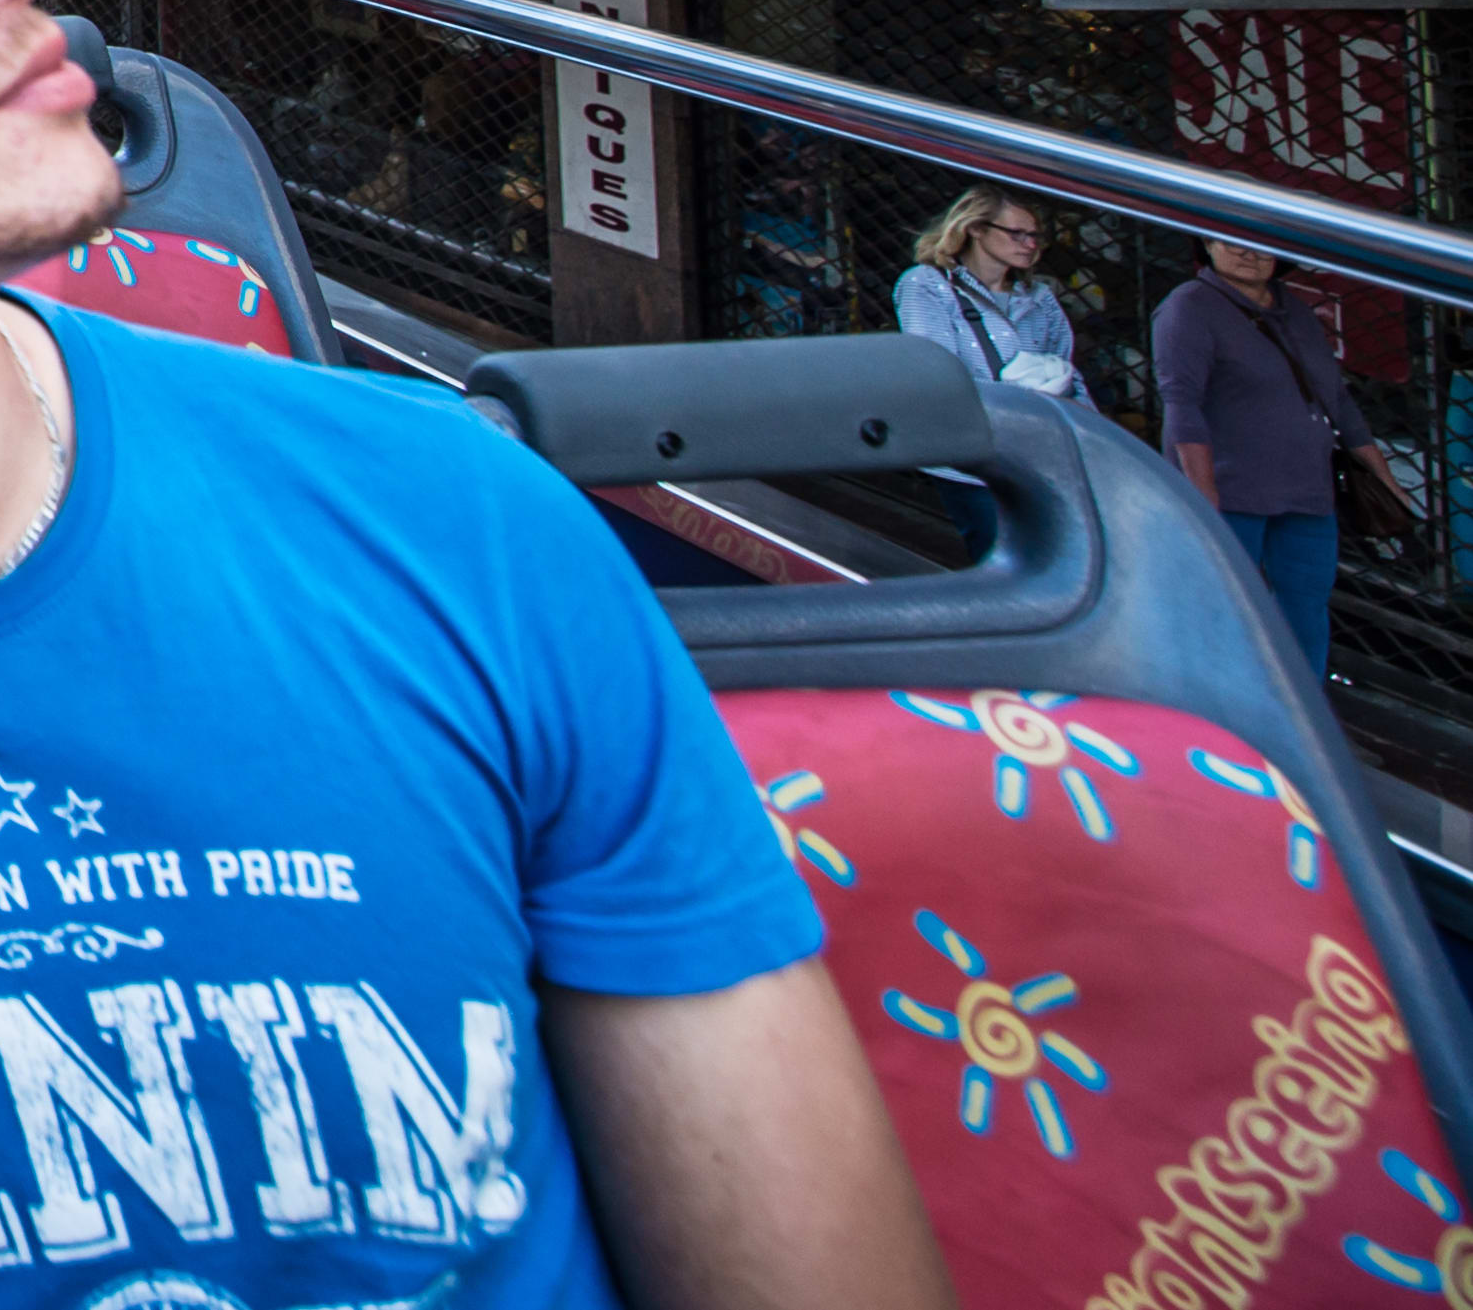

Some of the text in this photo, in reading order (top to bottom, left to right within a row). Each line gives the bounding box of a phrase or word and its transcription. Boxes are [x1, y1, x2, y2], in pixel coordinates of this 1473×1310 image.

[1175, 8, 1404, 191] SALE
[44, 850, 188, 904] WITH
[205, 850, 361, 904] PRIDE
